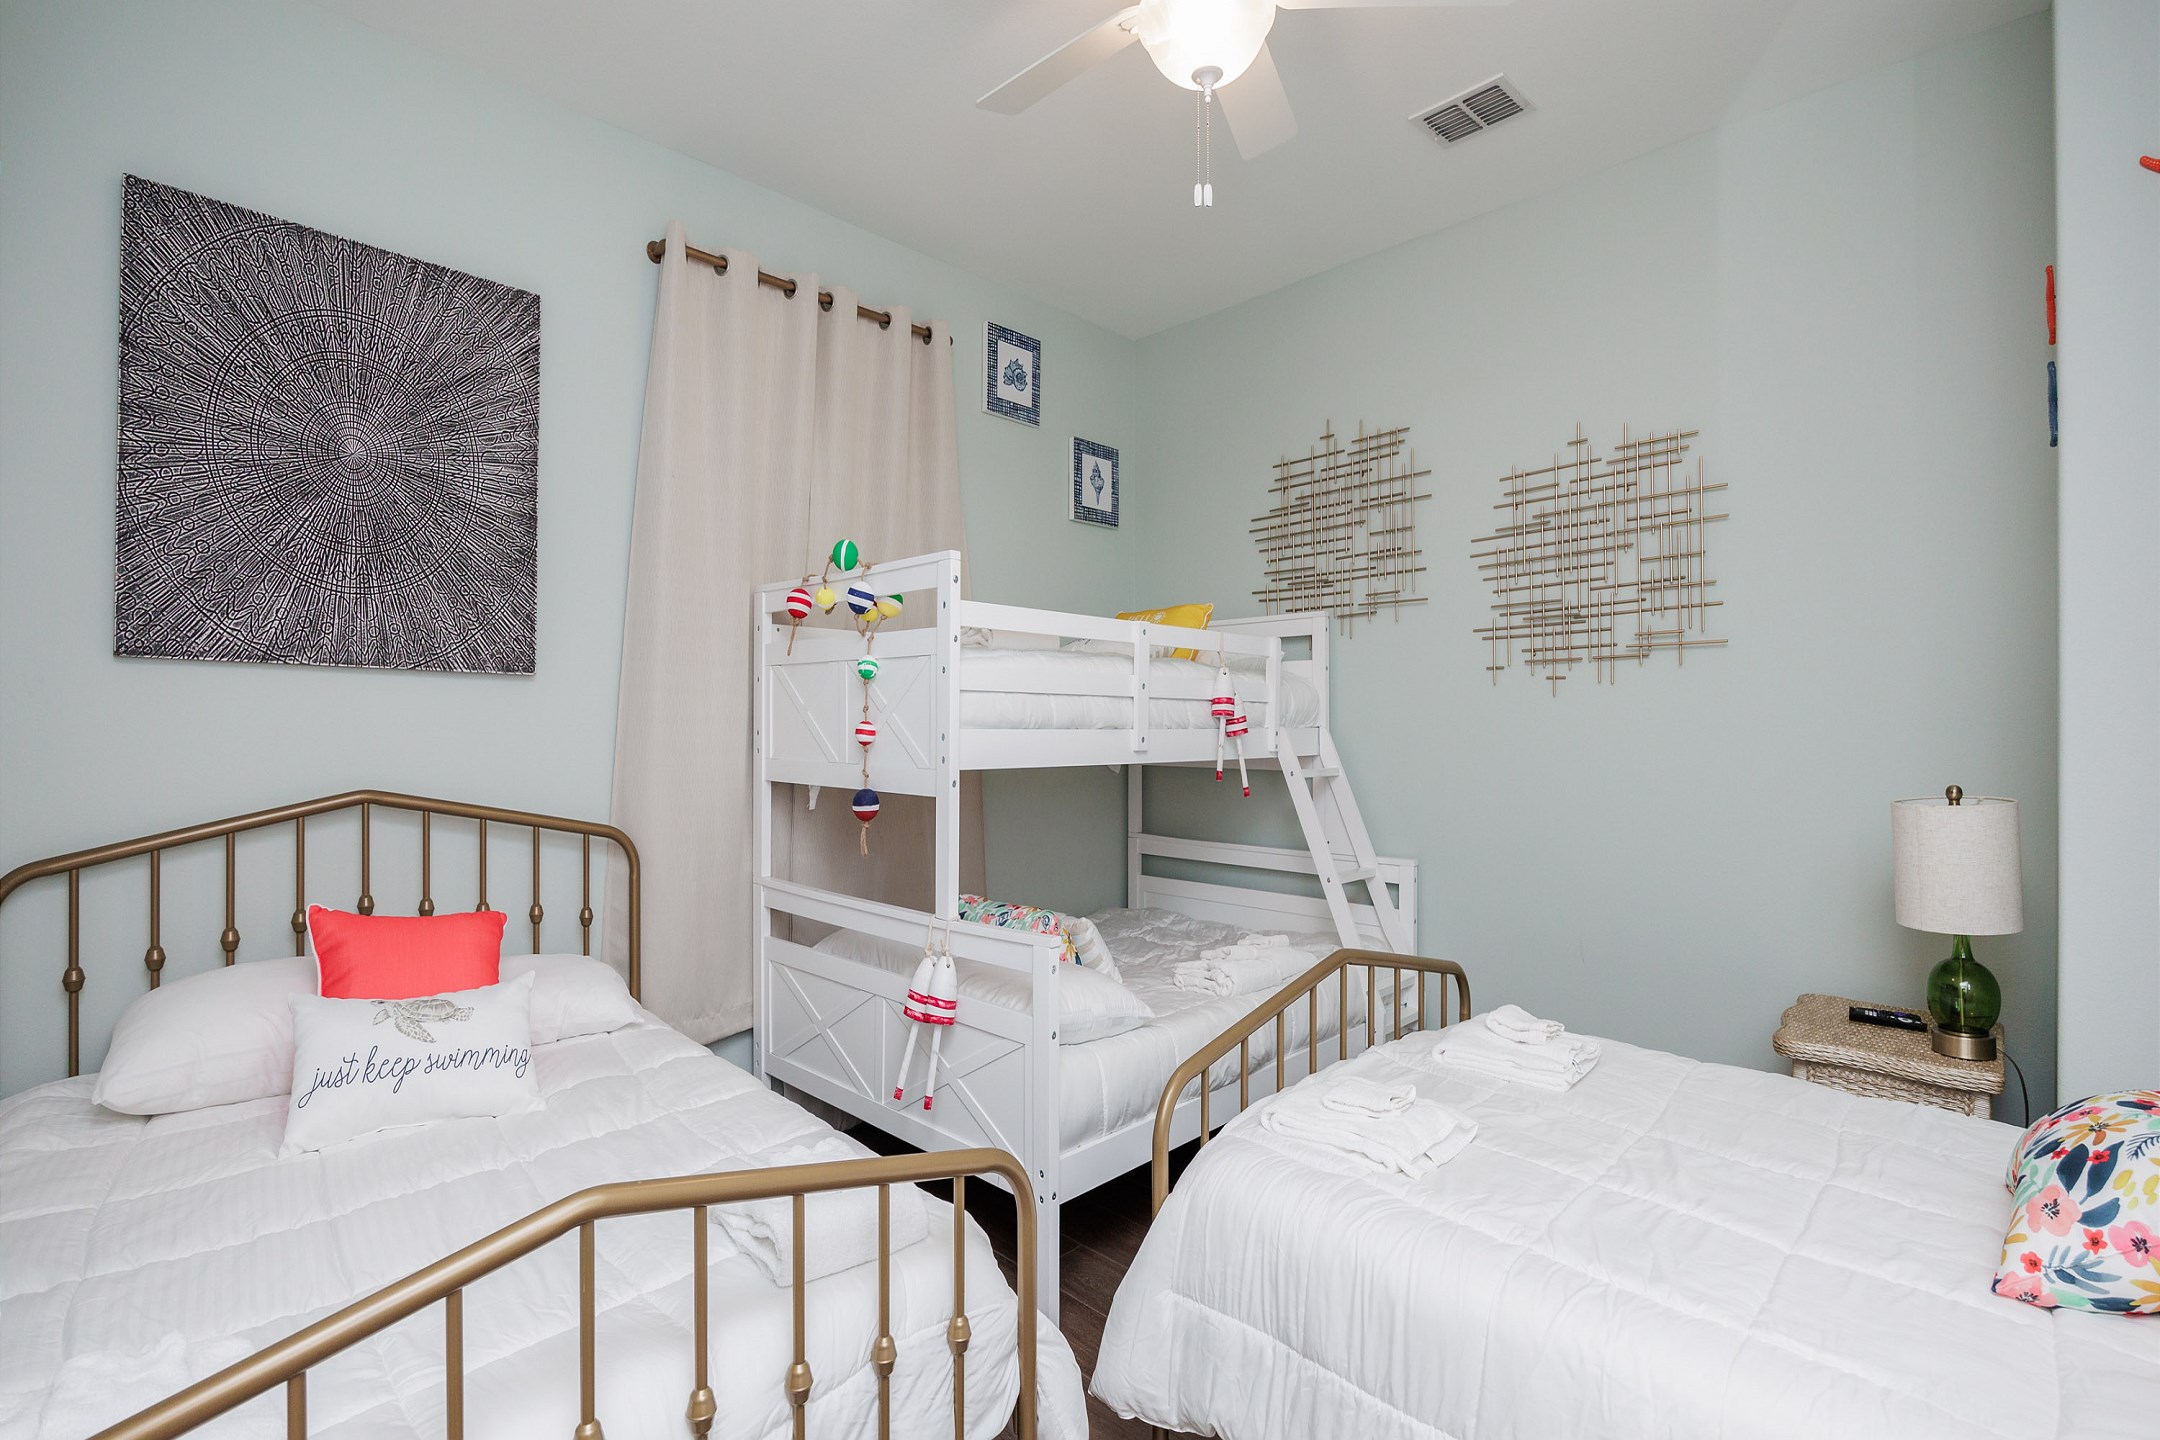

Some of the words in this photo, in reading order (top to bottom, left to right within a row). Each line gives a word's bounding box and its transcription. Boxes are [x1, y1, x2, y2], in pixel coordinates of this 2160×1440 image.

[297, 1052, 361, 1109] just
[361, 1045, 422, 1094] keep
[423, 1044, 532, 1079] swimming
